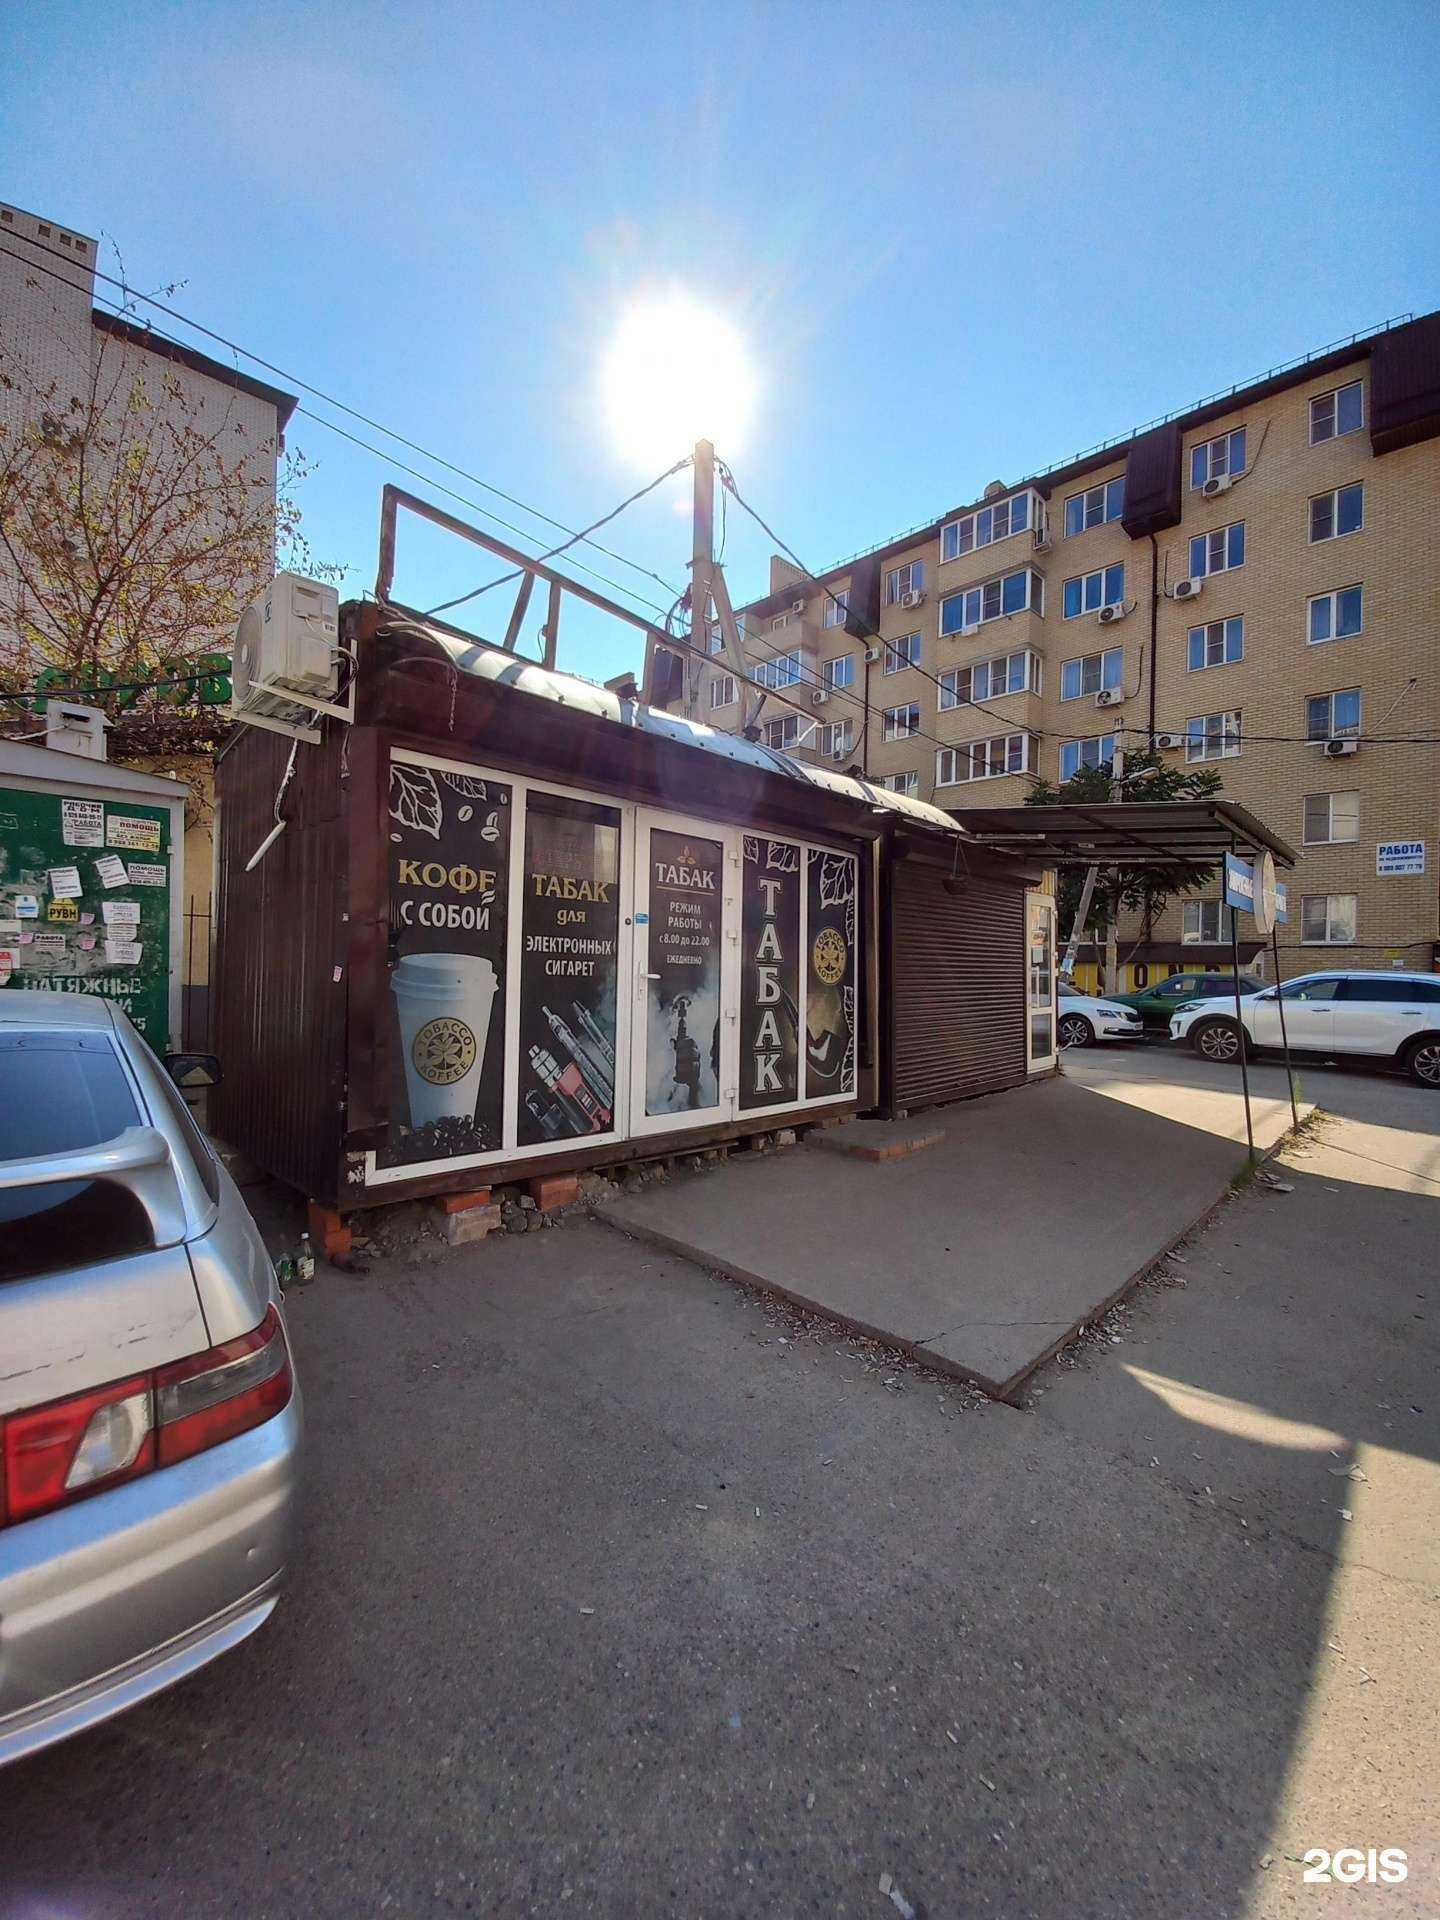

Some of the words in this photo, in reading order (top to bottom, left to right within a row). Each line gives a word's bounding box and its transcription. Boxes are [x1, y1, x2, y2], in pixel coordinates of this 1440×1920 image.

[120, 822, 159, 832] ПОМОЩЬ
[1379, 844, 1423, 855] РАБОТА
[129, 865, 165, 873] ПОМОЩЬ
[398, 859, 497, 894] КОФЕ
[656, 863, 715, 890] ТАБАК
[532, 873, 610, 903] ТАБАК
[400, 900, 414, 926] С
[418, 902, 490, 930] СОБОЙ
[557, 908, 586, 926] для
[670, 901, 701, 914] РЕЖИМ
[668, 916, 702, 929] РАБОТЫ
[526, 935, 613, 956] ЭЛЕКТРОННЫХ
[816, 932, 845, 953] TOBACCO
[545, 959, 595, 977] СИГАРЕТ
[666, 955, 702, 966] ЕЖЕДНЕВНО
[755, 878, 783, 1093] ТАБАК
[418, 1022, 472, 1047] TOBACCO
[420, 1060, 469, 1081] KOFFEE
